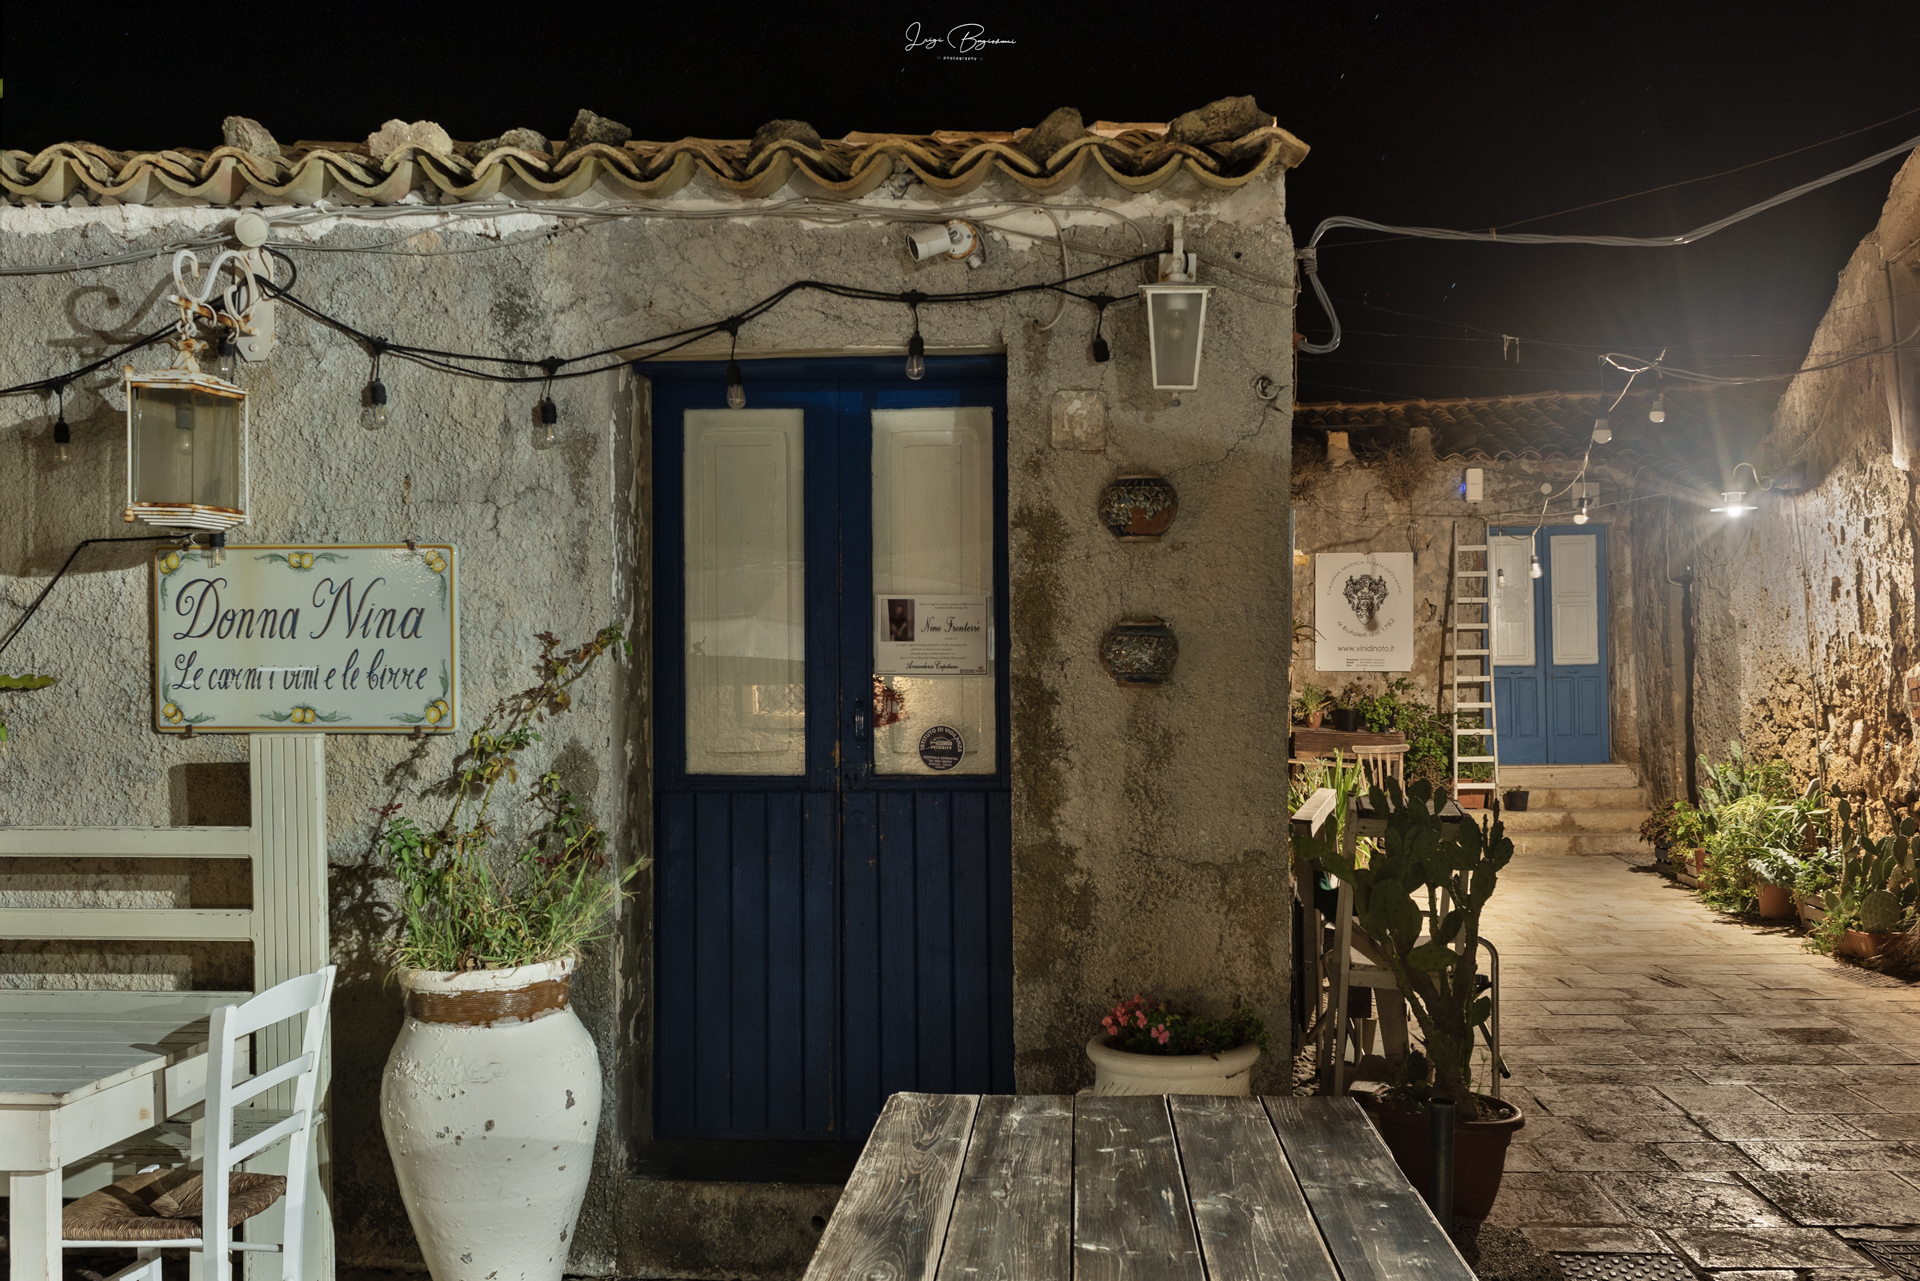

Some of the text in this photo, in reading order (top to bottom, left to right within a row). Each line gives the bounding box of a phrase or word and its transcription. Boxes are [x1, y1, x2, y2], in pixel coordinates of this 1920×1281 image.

[1327, 571, 1341, 596] CANTINA
[1341, 560, 1364, 571] MODICA
[1373, 561, 1384, 569] SAN
[1384, 566, 1402, 595] GIOVANNI
[173, 577, 426, 640] Donna Nina
[920, 616, 981, 633] Nino Fronterrè
[1369, 629, 1381, 638] dal
[1381, 617, 1396, 632] 1782
[1337, 644, 1395, 653] www.vinidinoto.it
[172, 648, 428, 690] Le carni i vini e le birre
[905, 660, 934, 670] Arrivederci
[934, 660, 959, 672] Capitano
[920, 728, 937, 750] ISTITUTO
[944, 727, 963, 753] VIGILANZA
